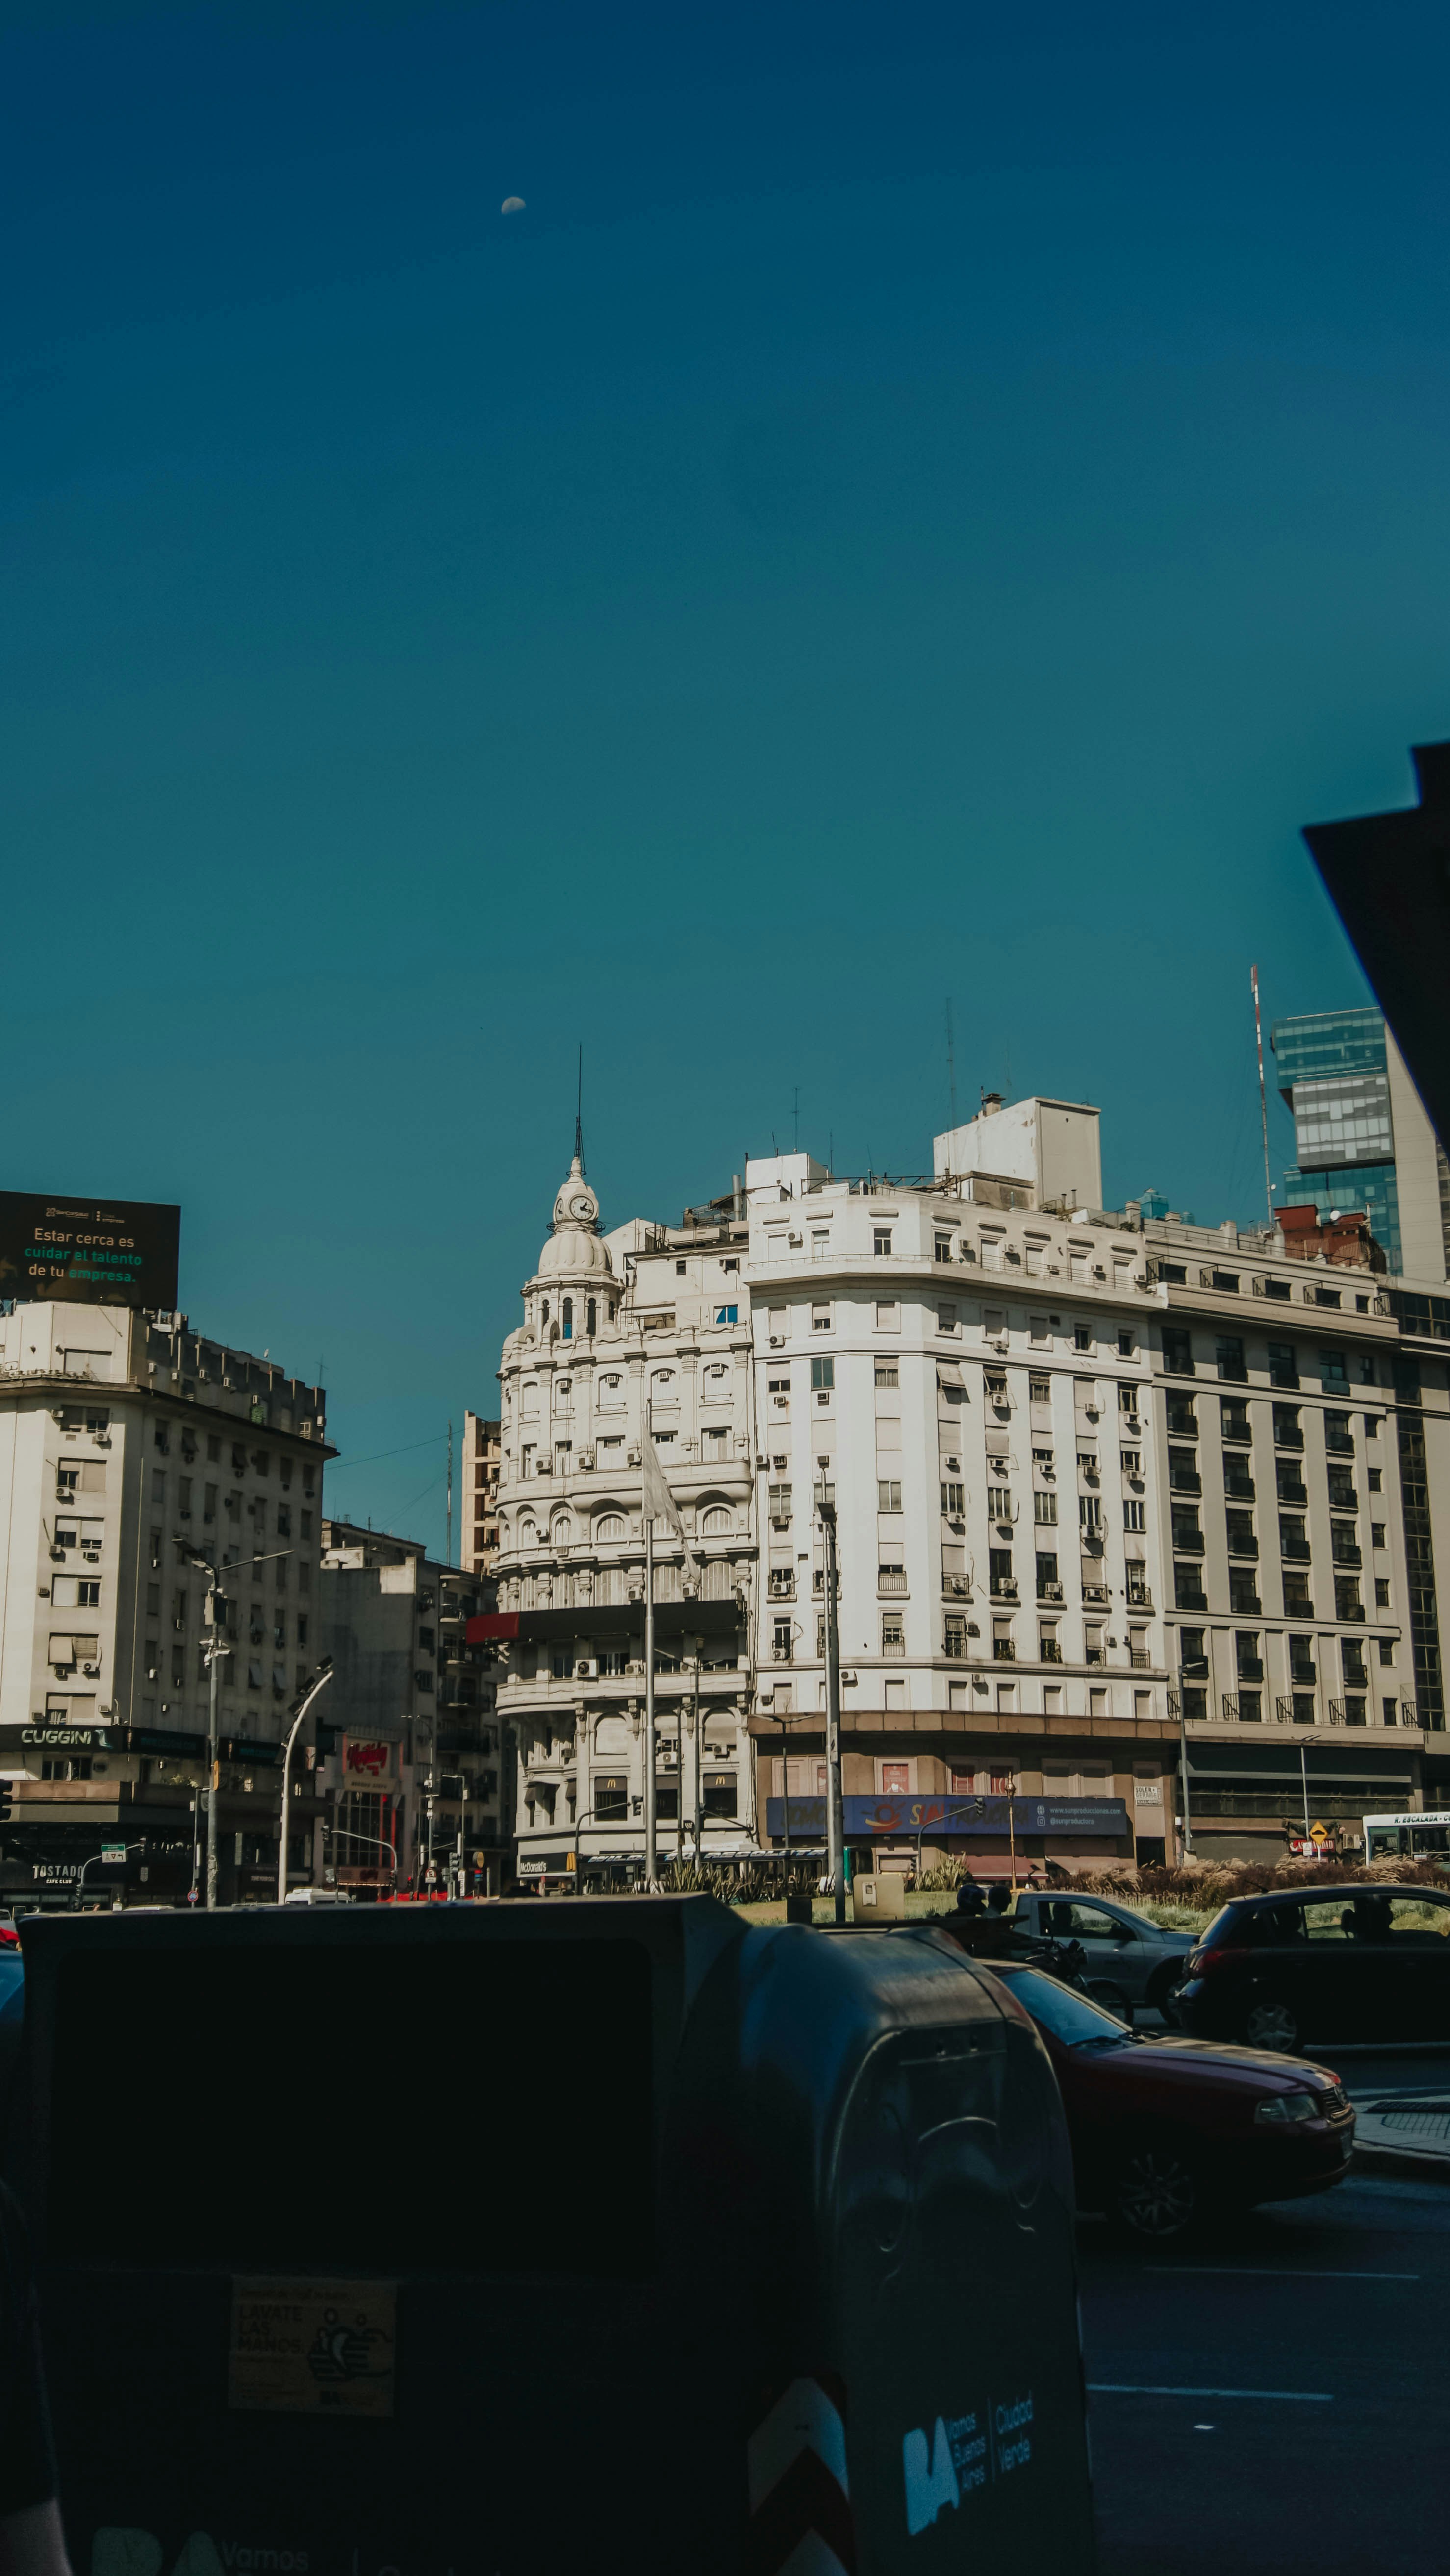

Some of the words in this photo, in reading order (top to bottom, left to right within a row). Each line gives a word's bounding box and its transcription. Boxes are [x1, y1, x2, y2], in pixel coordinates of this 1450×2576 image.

[34, 1227, 73, 1243] Estar
[76, 1234, 114, 1246] cerca
[119, 1237, 134, 1247] es
[25, 1246, 71, 1260] cuidar
[74, 1250, 88, 1261] el
[92, 1251, 142, 1265] talento
[29, 1263, 46, 1275] de
[50, 1265, 64, 1277] tu
[69, 1269, 136, 1282] empresa.
[21, 1729, 91, 1744] CUGGINI
[910, 1803, 944, 1826] SUN
[1402, 1815, 1438, 1823] ESCALADA
[32, 1865, 83, 1879] TOSTADO
[520, 1861, 547, 1873] McDonald's
[239, 2305, 303, 2322] LAVATE
[239, 2321, 270, 2336] LAS
[996, 2389, 1033, 2435] Ciudad
[945, 2412, 976, 2441] Vamos
[954, 2435, 986, 2469] Buenos
[998, 2430, 1031, 2474] Verde
[961, 2464, 985, 2492] Aires
[219, 2539, 309, 2573] Vamos
